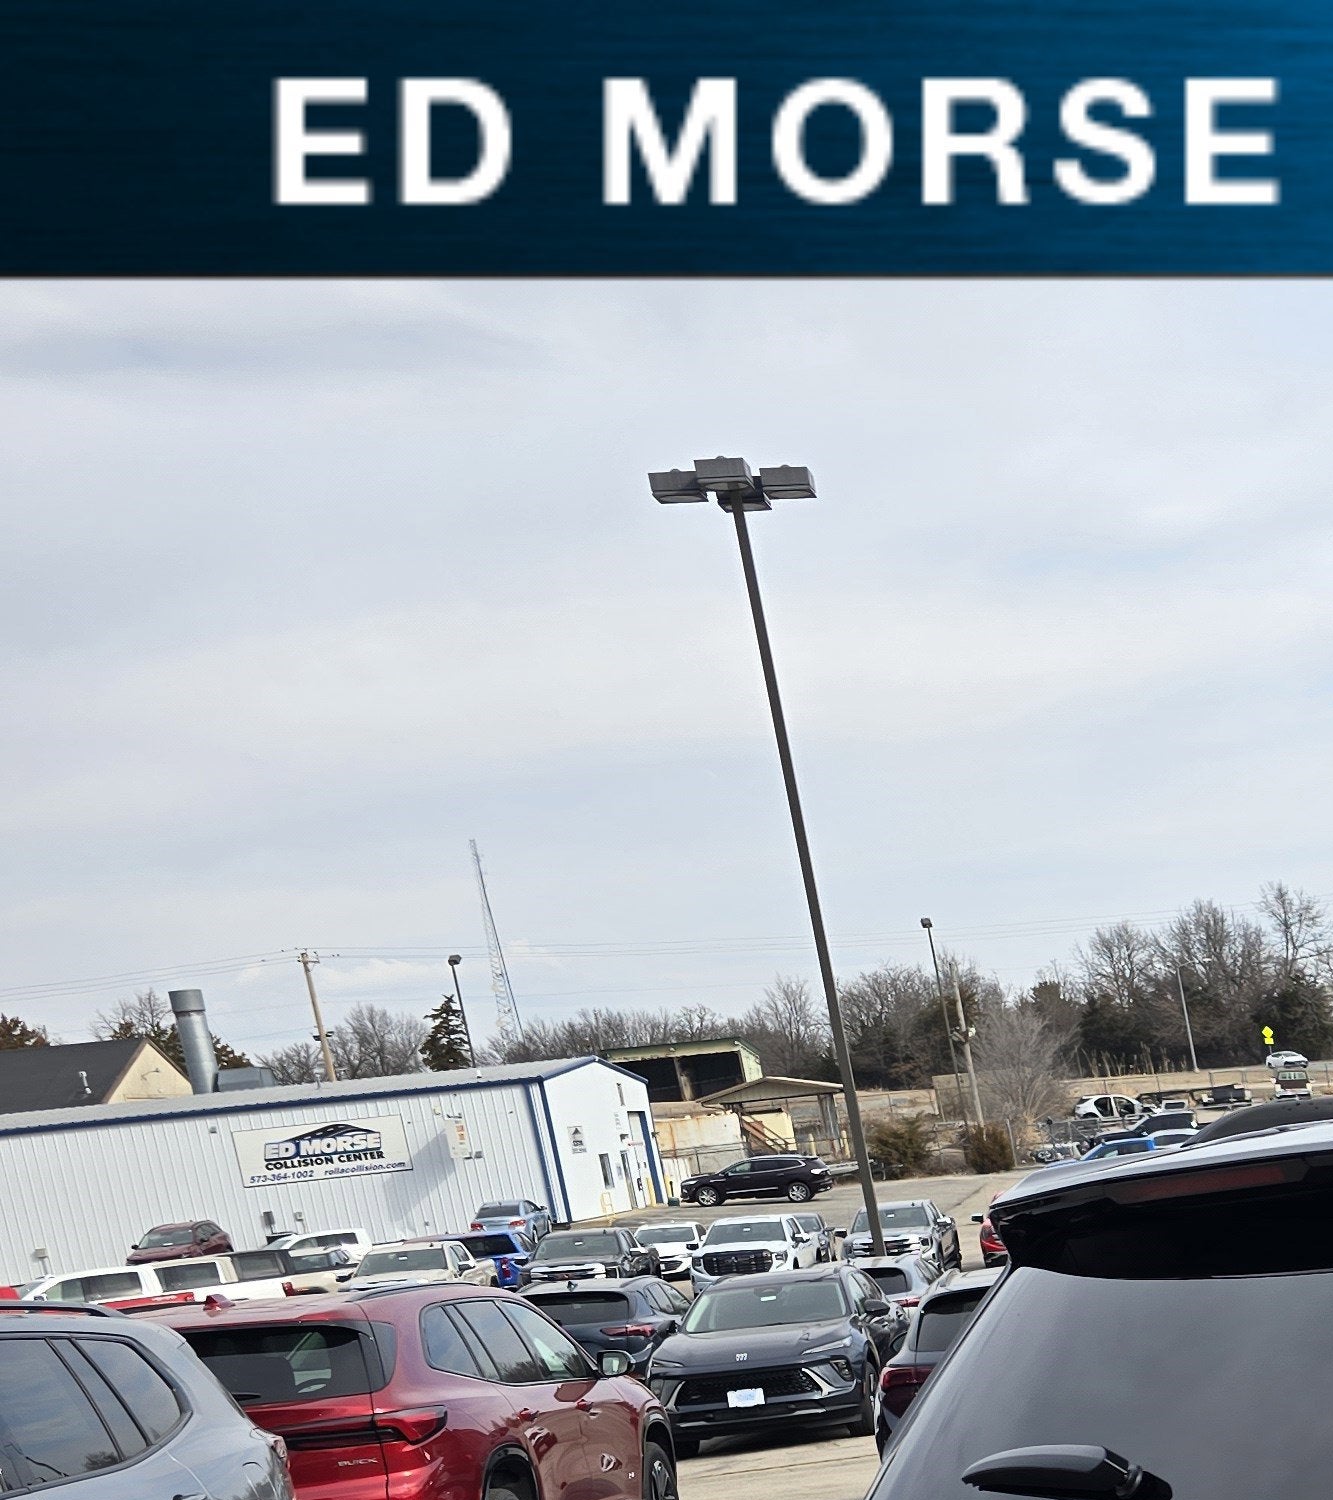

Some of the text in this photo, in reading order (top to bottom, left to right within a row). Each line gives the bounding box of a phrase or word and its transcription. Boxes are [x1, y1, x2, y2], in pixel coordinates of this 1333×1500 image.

[265, 1132, 381, 1160] ED MORSE
[265, 1150, 385, 1171] COLLISION CENTER
[249, 1161, 406, 1184] 573-364-1002 rollacollision.com
[338, 1457, 378, 1467] BUICK
